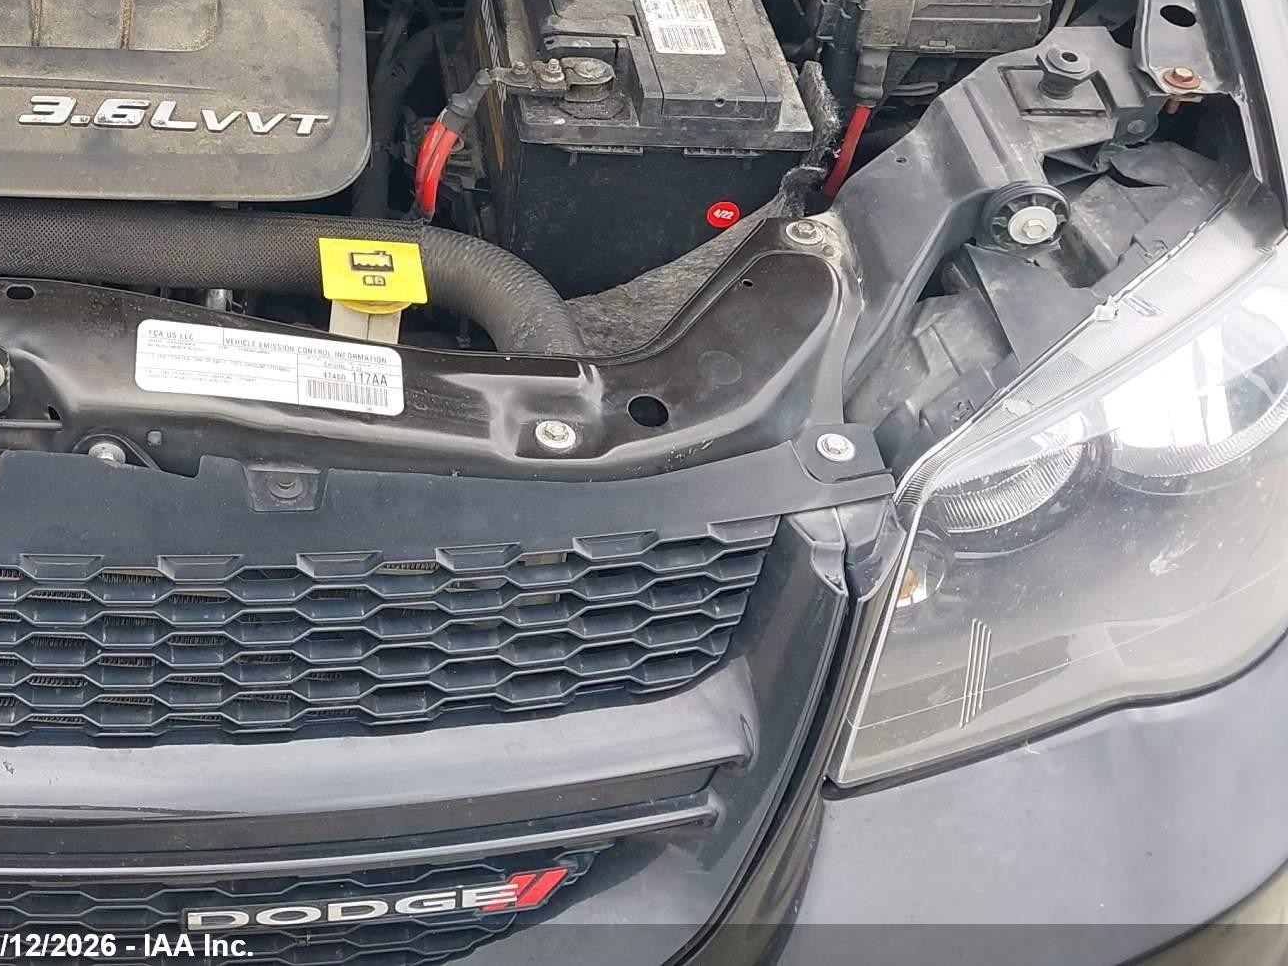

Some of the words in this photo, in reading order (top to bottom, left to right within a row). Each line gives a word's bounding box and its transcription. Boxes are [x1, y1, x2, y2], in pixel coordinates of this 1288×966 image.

[166, 331, 178, 340] US
[225, 337, 257, 348] VEHICLE
[258, 341, 295, 353] EMISSION
[297, 346, 332, 357] CONTROL
[334, 351, 388, 364] INFORMATION
[351, 371, 388, 387] 117AA
[187, 884, 518, 932] DODGE
